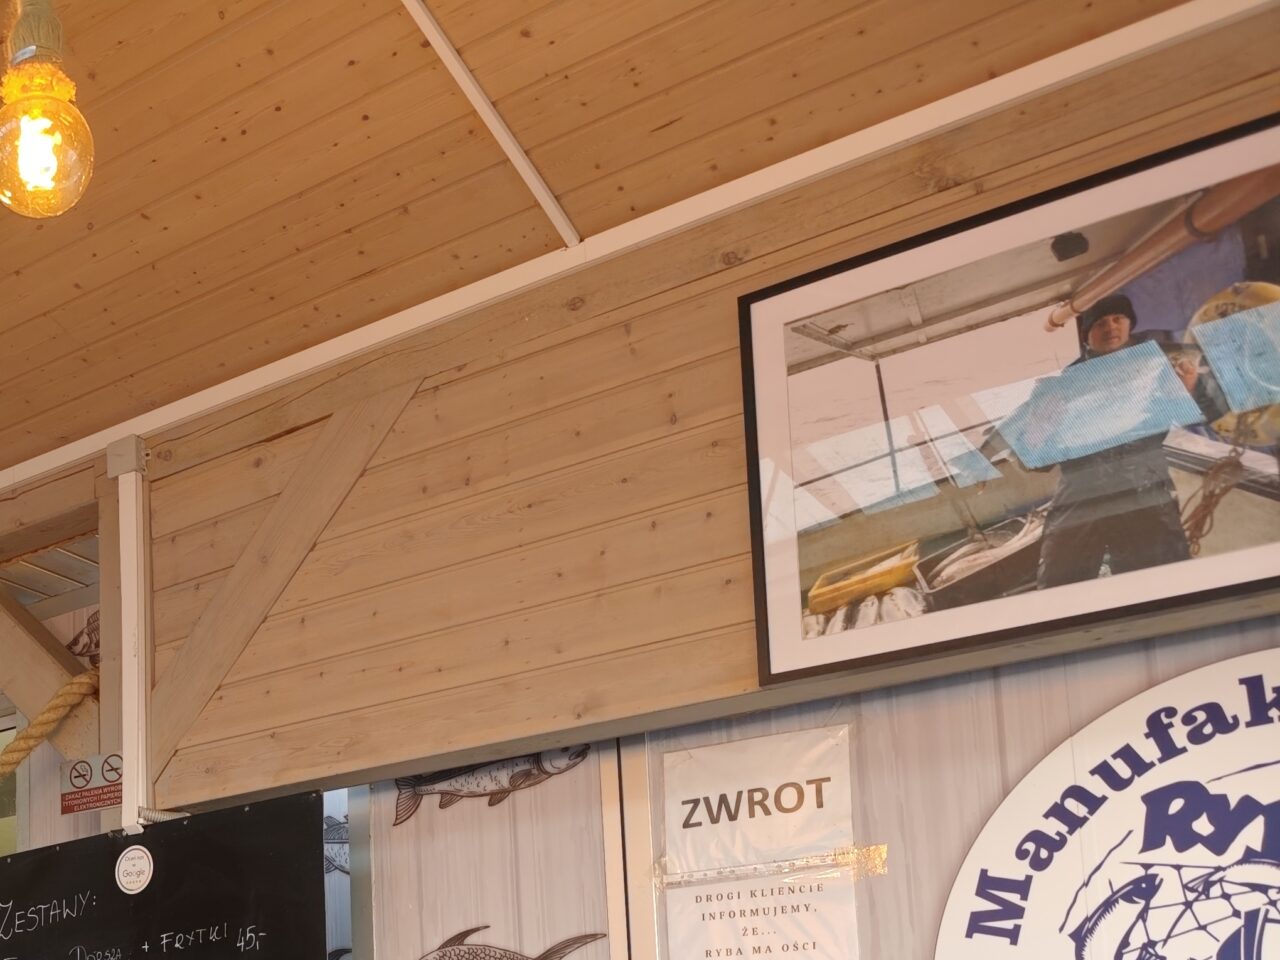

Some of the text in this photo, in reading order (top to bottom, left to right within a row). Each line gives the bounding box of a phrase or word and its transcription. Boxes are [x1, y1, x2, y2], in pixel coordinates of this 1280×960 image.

[681, 777, 831, 829] ZWROT
[695, 883, 824, 904] DROGI KLIENCIE
[702, 903, 818, 921] INFORMUJEMY,
[705, 941, 817, 958] RYBA MA OŚCI
